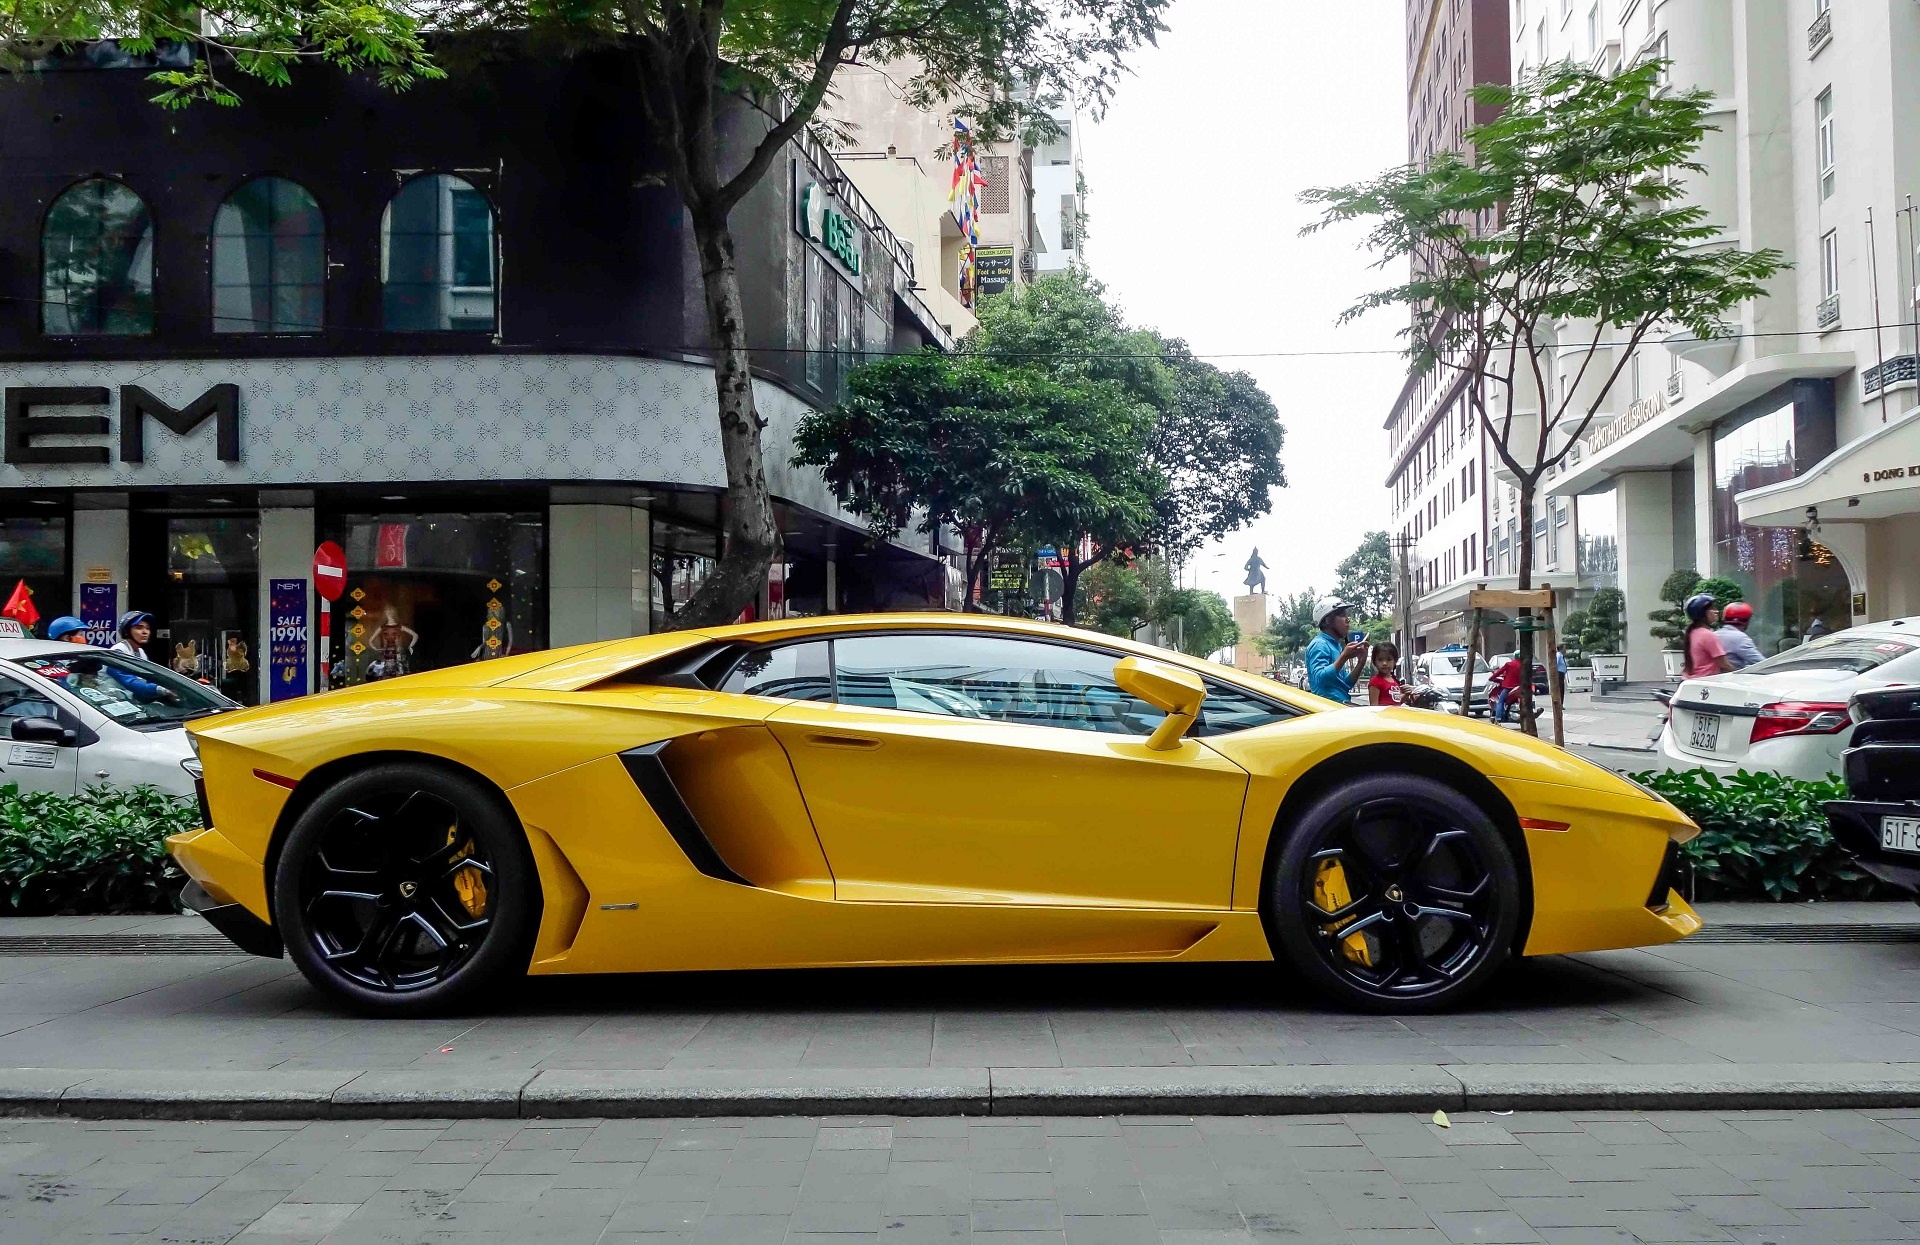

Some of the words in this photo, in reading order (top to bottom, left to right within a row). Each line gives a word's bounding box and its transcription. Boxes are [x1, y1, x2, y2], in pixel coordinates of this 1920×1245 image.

[824, 208, 862, 276] Bean
[978, 258, 1010, 267] マッサージ
[980, 276, 1008, 284] Massage
[1607, 410, 1632, 444] HOTEL
[1631, 390, 1662, 429] SAIGON
[1863, 472, 1870, 483] 8
[1873, 467, 1904, 481] DONG
[87, 586, 111, 594] NEM
[87, 619, 112, 629] SALE
[277, 616, 302, 626] SALE
[0, 622, 20, 634] TAXI
[270, 626, 307, 641] 199K
[301, 643, 306, 653] 2
[1698, 717, 1713, 733] 51F
[1691, 731, 1716, 749] 34230
